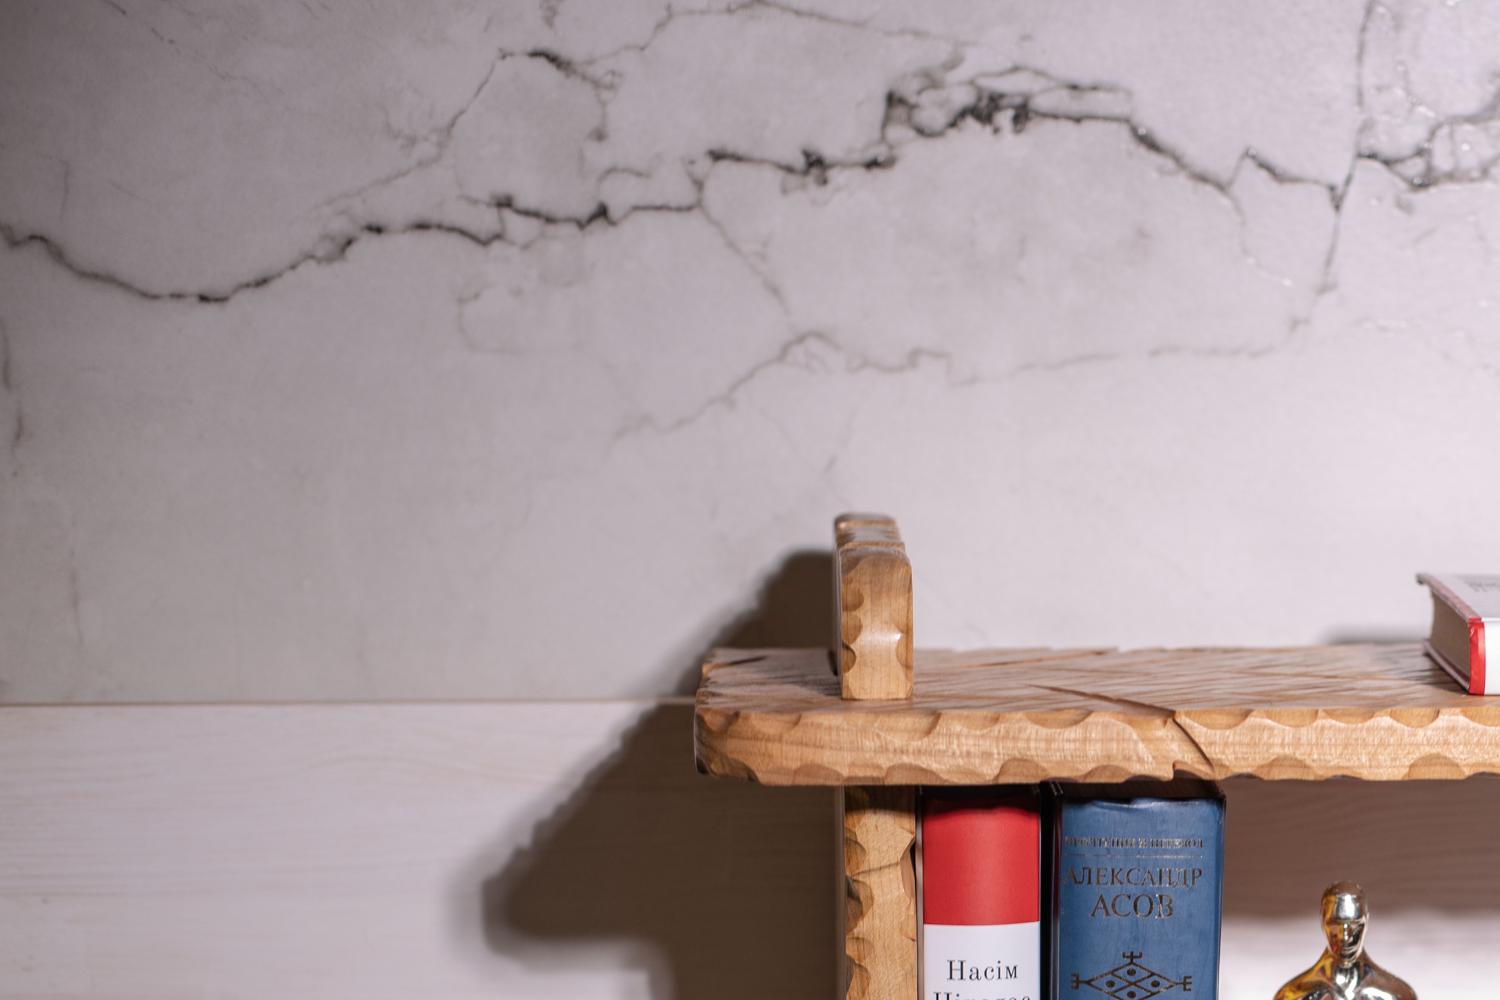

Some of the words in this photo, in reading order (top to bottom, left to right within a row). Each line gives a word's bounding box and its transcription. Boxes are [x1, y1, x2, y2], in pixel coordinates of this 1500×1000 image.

[1067, 867, 1203, 888] АЛЕКСАНДР
[1090, 893, 1175, 919] АСОВ
[946, 959, 1019, 981] Насім
